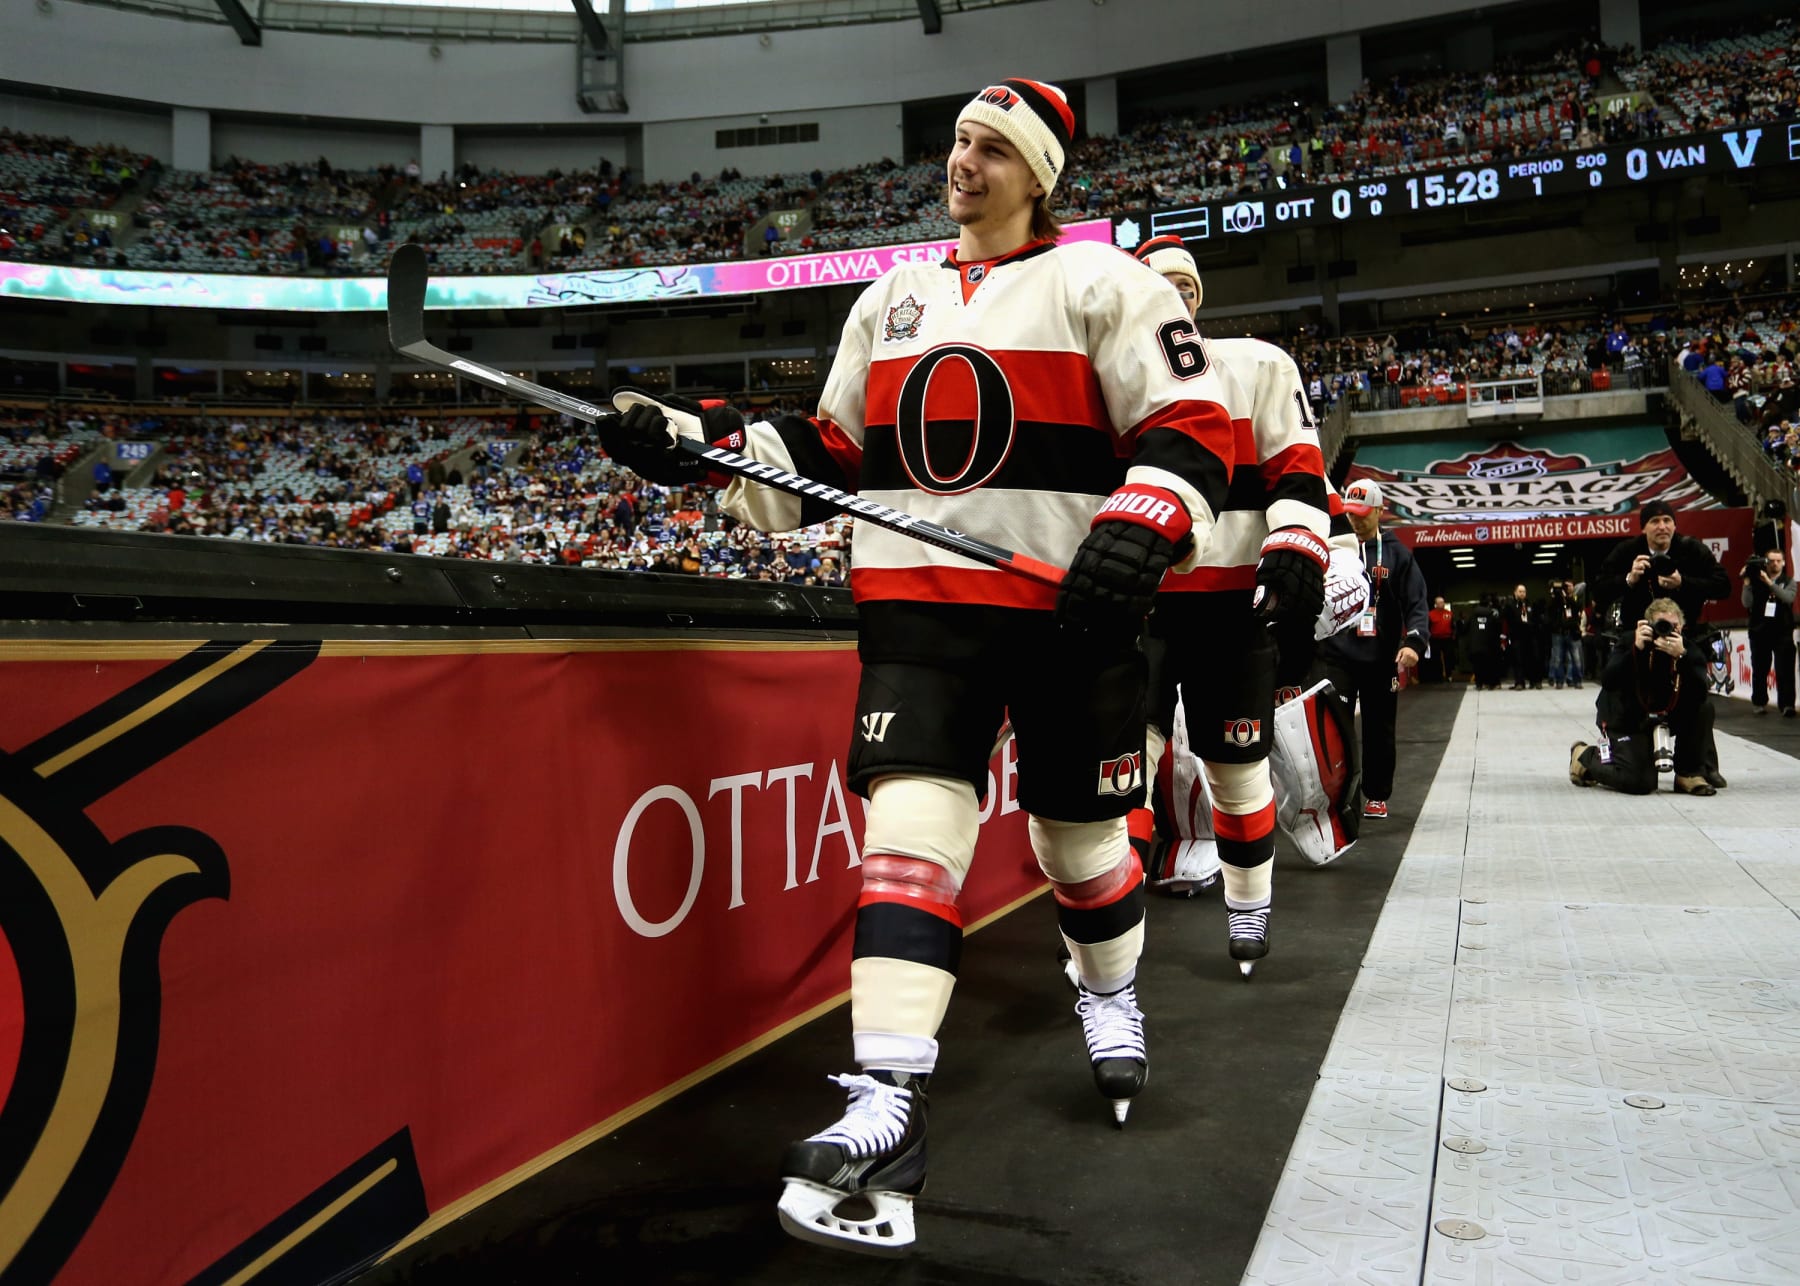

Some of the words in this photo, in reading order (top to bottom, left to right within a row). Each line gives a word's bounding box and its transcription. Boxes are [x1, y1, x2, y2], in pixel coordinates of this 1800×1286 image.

[1576, 152, 1607, 169] SOG
[1626, 148, 1648, 181] 0
[1656, 144, 1706, 170] VAN
[1722, 128, 1762, 169] V
[1508, 158, 1564, 178] PERIOD
[1589, 170, 1602, 187] 0
[1358, 182, 1388, 199] SOG
[1405, 168, 1500, 210] 15:28
[1532, 177, 1543, 196] 1
[1275, 198, 1315, 221] OTT
[1332, 188, 1351, 220] 0
[1370, 200, 1382, 216] 0
[766, 253, 884, 286] OTTAWA
[1155, 316, 1210, 381] 6
[1486, 461, 1534, 478] NHL
[701, 447, 914, 528] WARRIOR
[1380, 470, 1668, 499] HERITAGE
[1415, 530, 1434, 543] Tim
[1435, 527, 1472, 542] Hortons
[1492, 523, 1564, 540] HERITAGE
[1567, 518, 1631, 535] CLASSIC
[612, 758, 870, 938] OTTA
